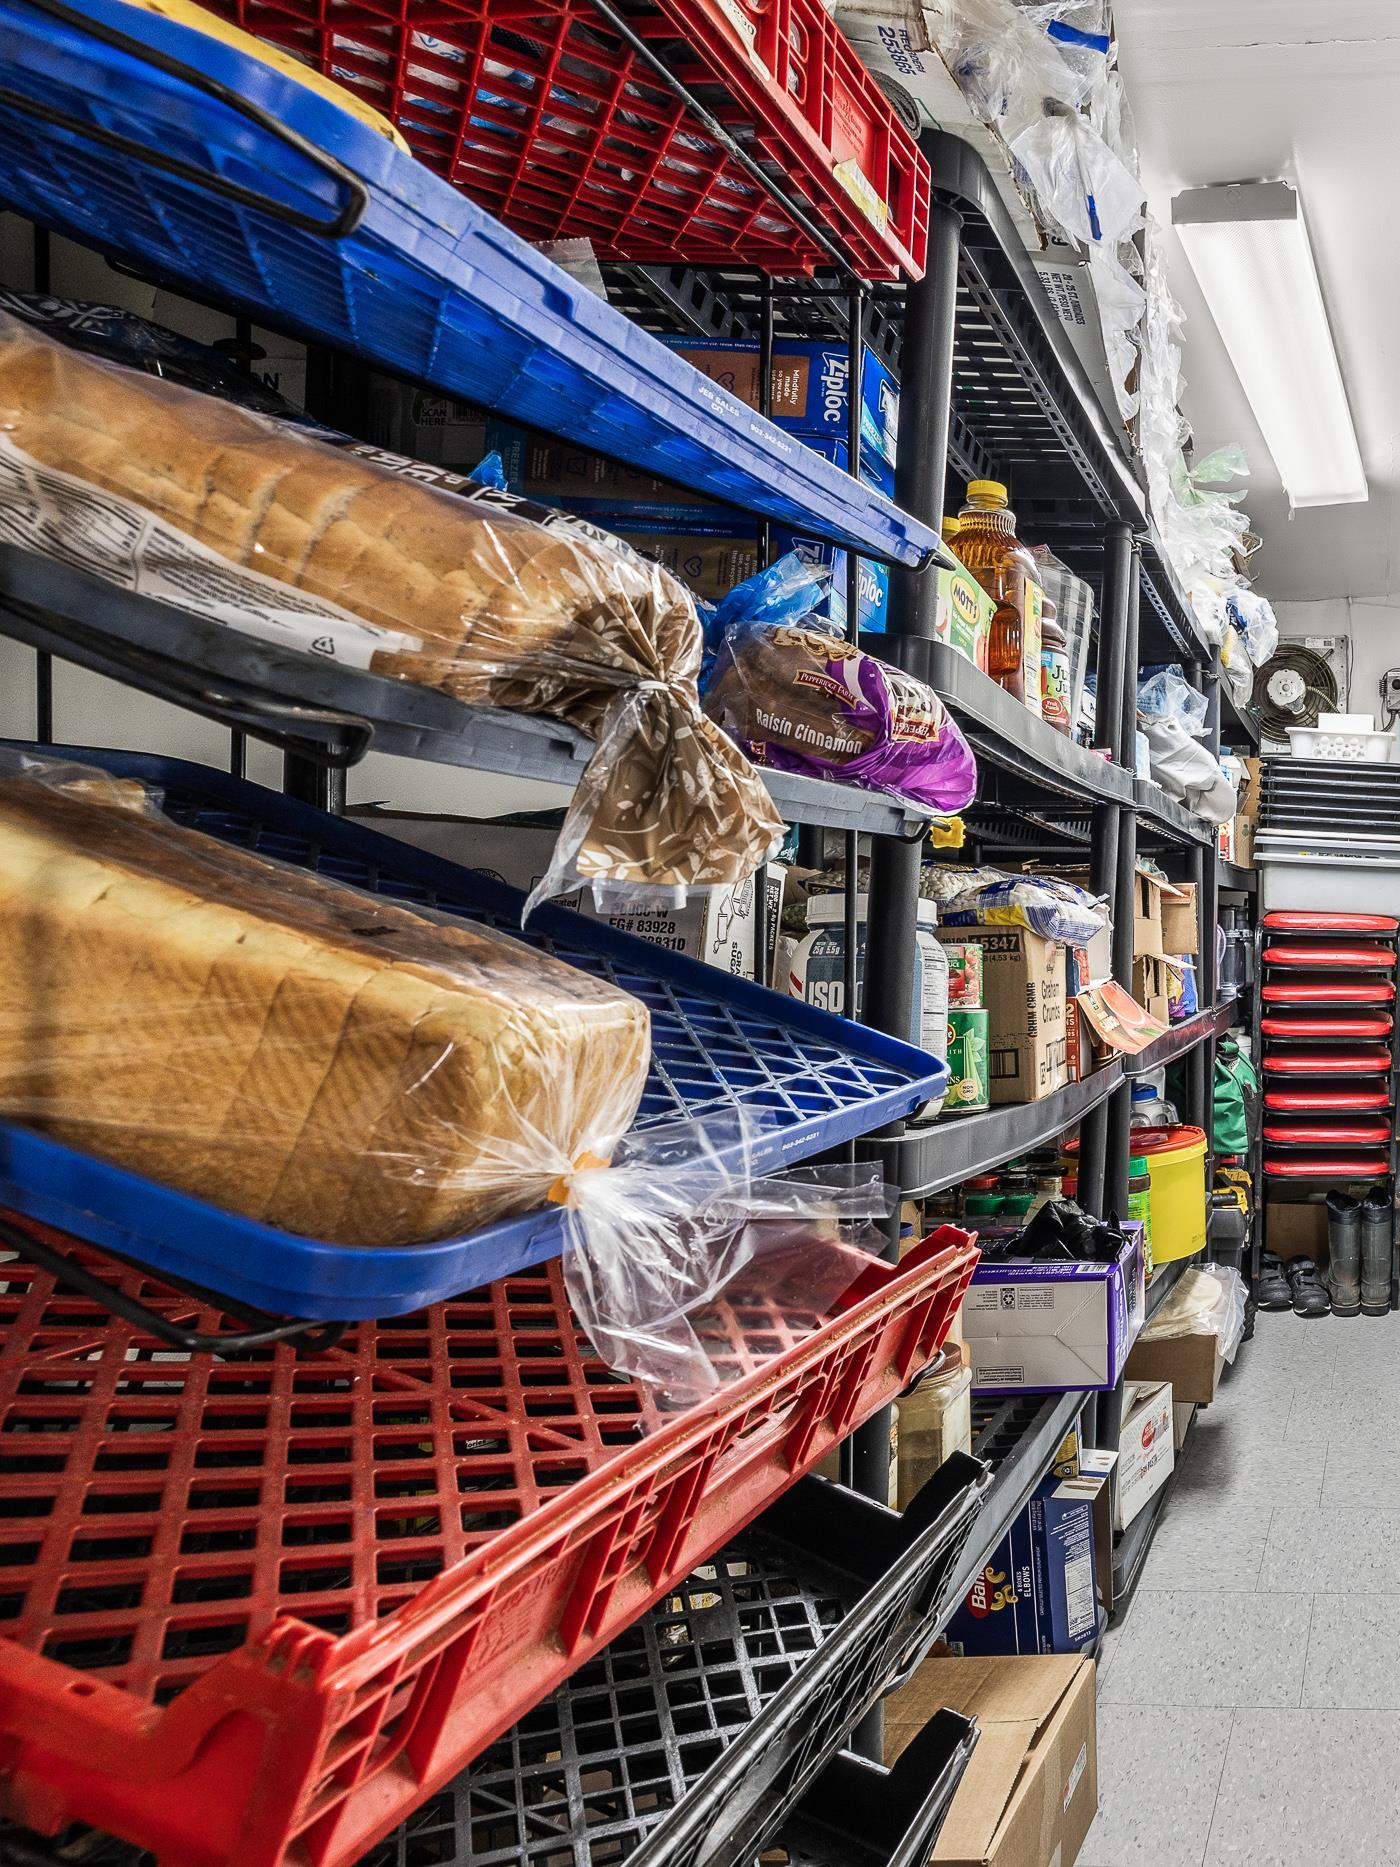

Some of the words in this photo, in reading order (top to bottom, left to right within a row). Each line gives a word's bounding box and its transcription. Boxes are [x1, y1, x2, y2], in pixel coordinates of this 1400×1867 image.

[877, 25, 917, 75] 253865
[783, 376, 791, 397] made
[790, 369, 801, 405] Mindfully
[821, 358, 849, 424] Ziploc
[420, 417, 447, 426] HERE
[421, 408, 447, 416] SCAN
[858, 567, 883, 607] iploc
[800, 671, 838, 692] PEPPERIDGE
[837, 685, 855, 700] FARM
[756, 708, 792, 736] Raisin
[794, 722, 862, 755] Cinnamon
[637, 920, 676, 934] 83928
[970, 936, 1018, 951] 15347
[730, 941, 738, 975] SUGA
[1026, 982, 1037, 1008] CRMB
[1041, 980, 1060, 999] Graham
[1027, 1011, 1038, 1038] GRHM
[1042, 1003, 1061, 1023] Crumbs
[1023, 1565, 1032, 1597] ELBOWS
